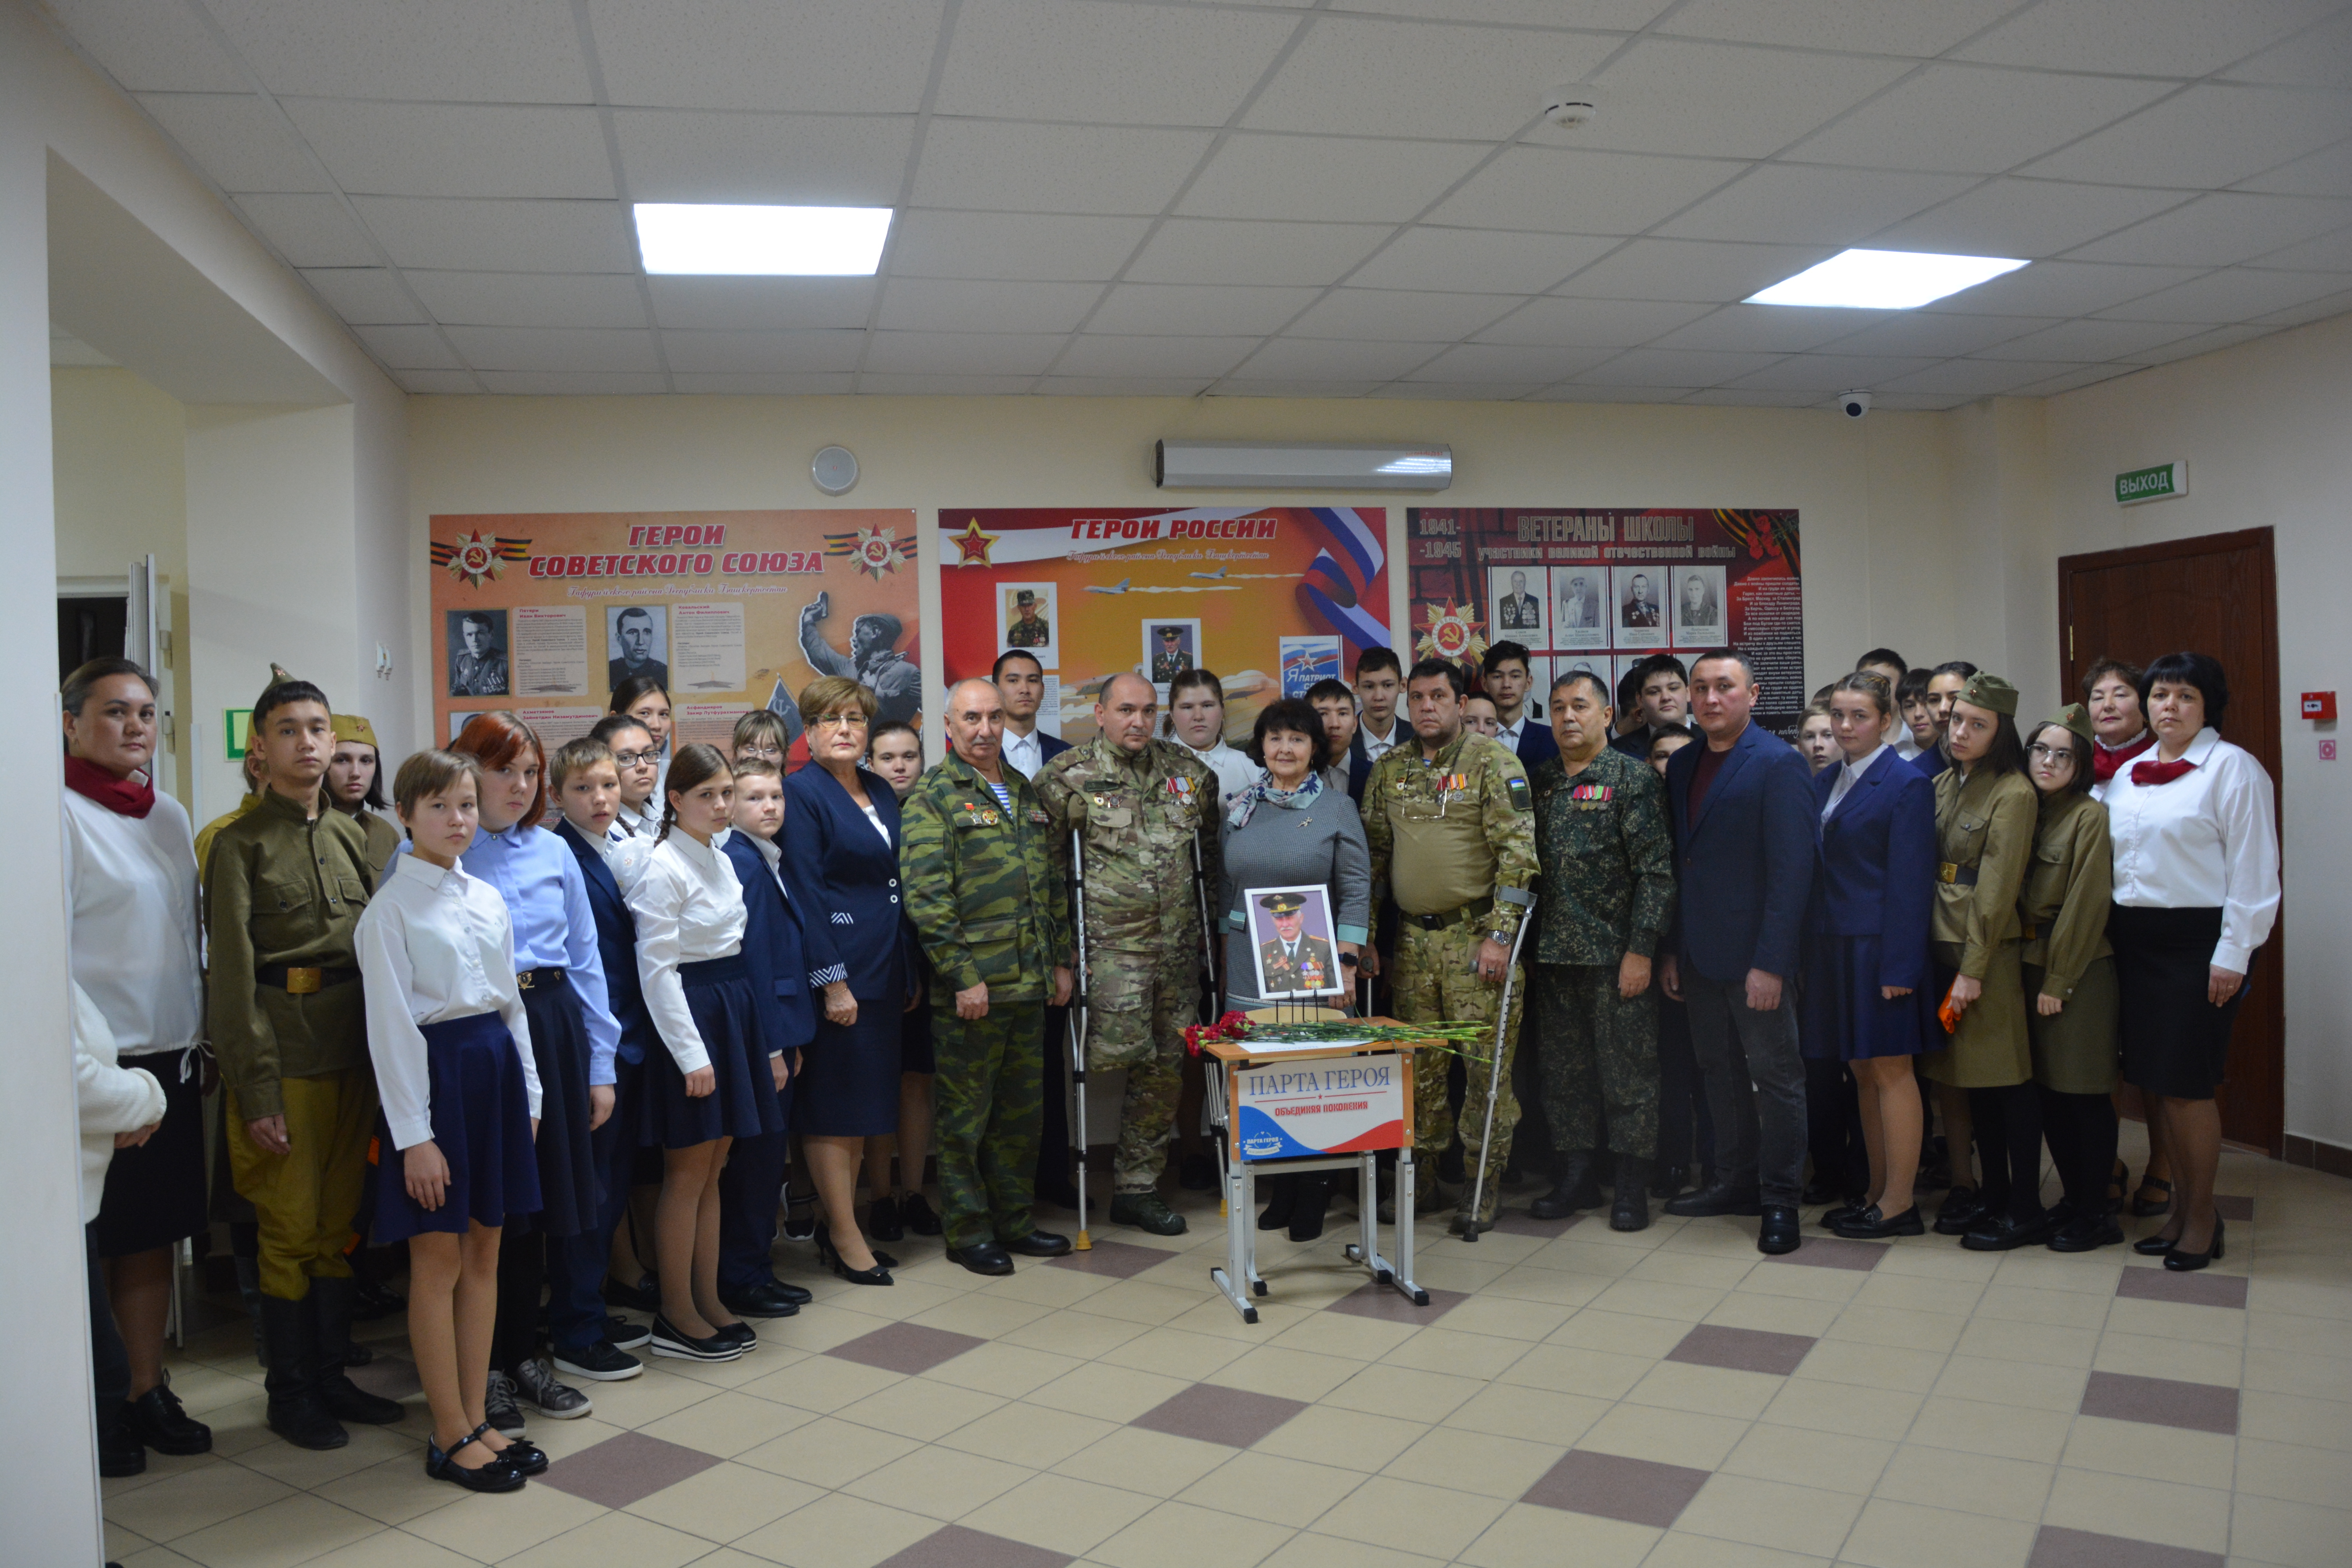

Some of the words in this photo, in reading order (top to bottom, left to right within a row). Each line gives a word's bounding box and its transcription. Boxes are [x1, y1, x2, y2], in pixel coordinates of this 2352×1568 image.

[2120, 471, 2169, 495] ВЫХОД
[628, 525, 725, 546] ГЕРОИ
[1071, 519, 1160, 539] ГЕРОИ
[1169, 519, 1277, 539] РОССИИ
[1420, 519, 1461, 535] 1941-
[1517, 516, 1615, 542] ВЕТЕРАНЫ
[1624, 516, 1694, 542] ШКОЛЫ
[1126, 553, 1156, 562] района
[1157, 549, 1203, 563] Республики
[1206, 549, 1269, 561] Башкортостан
[1419, 542, 1461, 558] -1945
[1477, 547, 1543, 561] участники
[1548, 545, 1598, 559] великой
[1604, 544, 1693, 558] отечественной
[1698, 544, 1736, 558] войны
[529, 553, 713, 577] СОВЕТСКОГО
[722, 552, 824, 573] СОЮЗА
[631, 588, 662, 598] района
[665, 583, 714, 597] Республики
[718, 583, 787, 595] Башкортостан
[1287, 668, 1299, 682] Я
[1299, 674, 1336, 682] ПАТРИОТ
[1249, 1072, 1319, 1095] ПАРТА
[1325, 1067, 1390, 1090] ГЕРОЯ
[1275, 1104, 1321, 1116] ОБЪЕДИНЯЯ
[1323, 1101, 1368, 1112] ПОКОЛЕНИЯ
